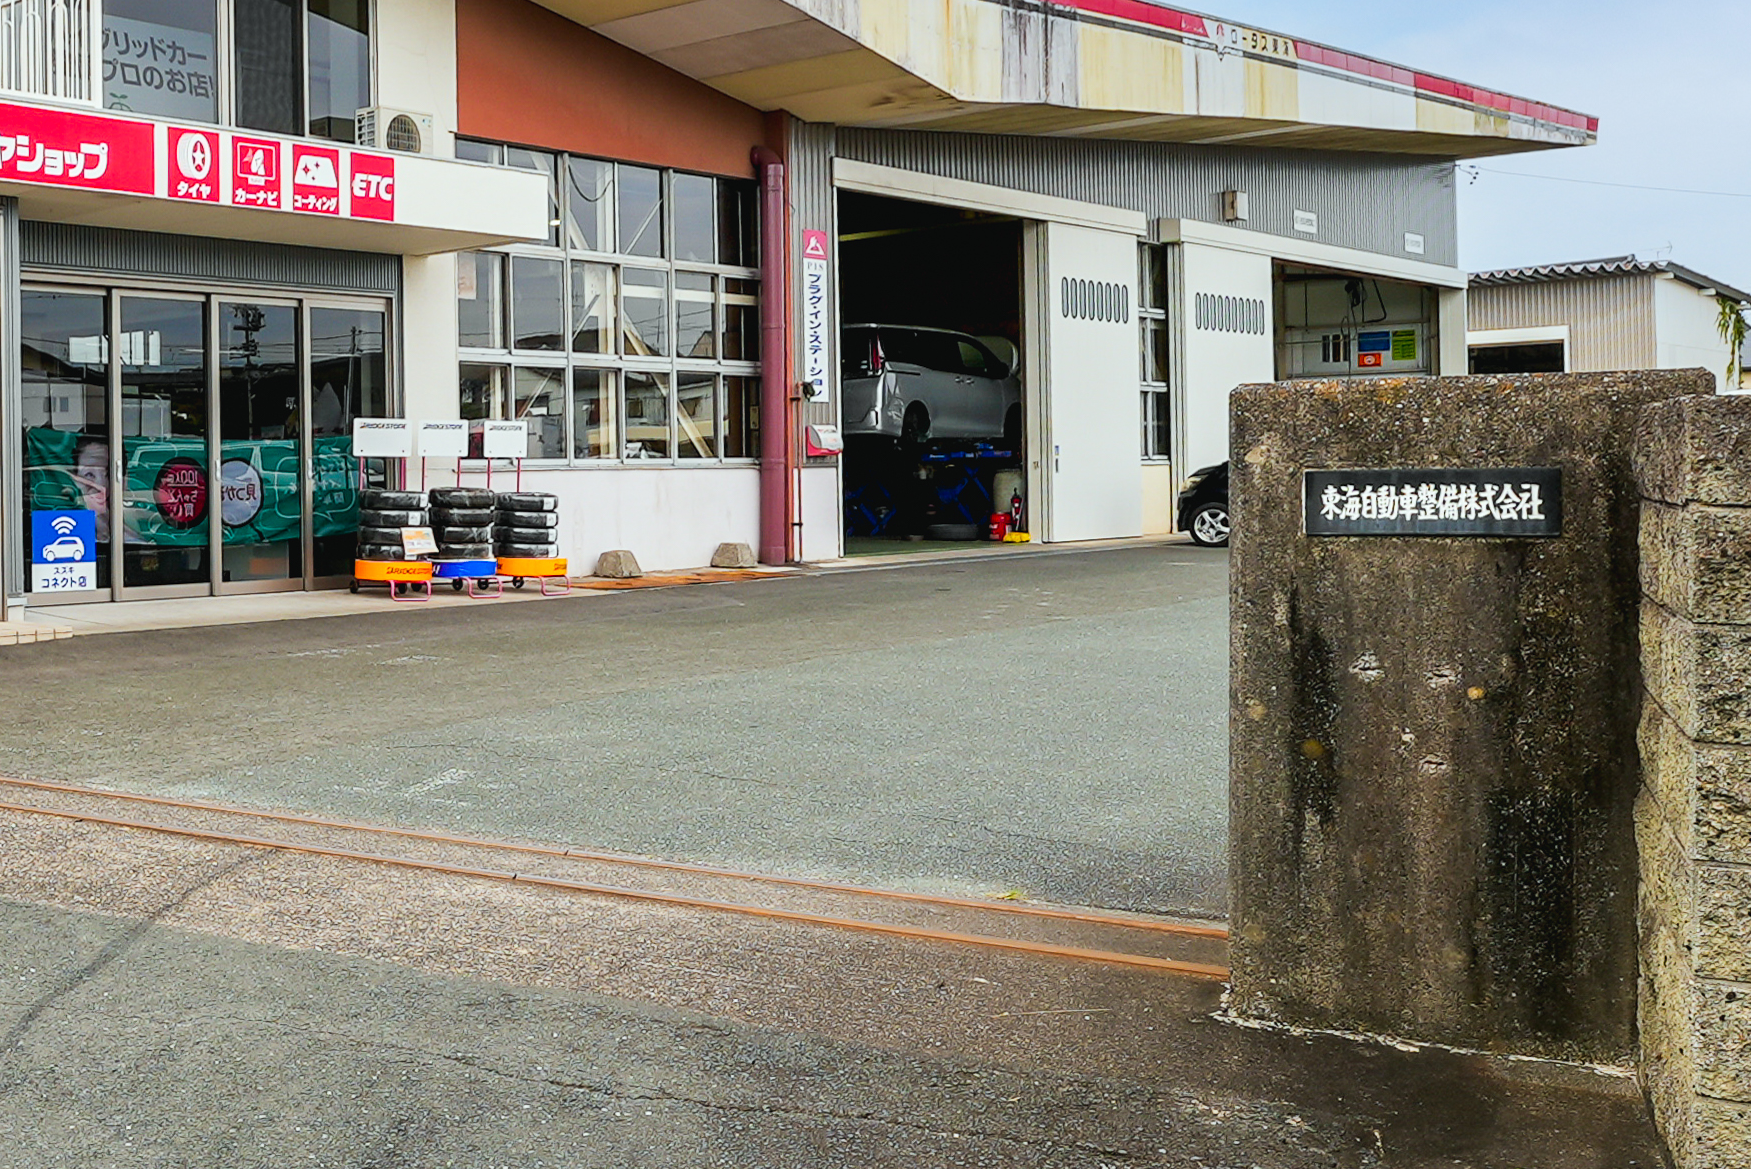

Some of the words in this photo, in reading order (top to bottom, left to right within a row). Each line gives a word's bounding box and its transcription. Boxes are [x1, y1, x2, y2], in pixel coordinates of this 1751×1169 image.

[176, 182, 212, 198] タイヤ
[351, 172, 394, 201] ETC
[234, 188, 279, 207] カーナビ
[293, 194, 338, 212] コーティング
[1320, 483, 1545, 521] 東海自動車整備株式会社
[41, 576, 87, 588] コネクト店
